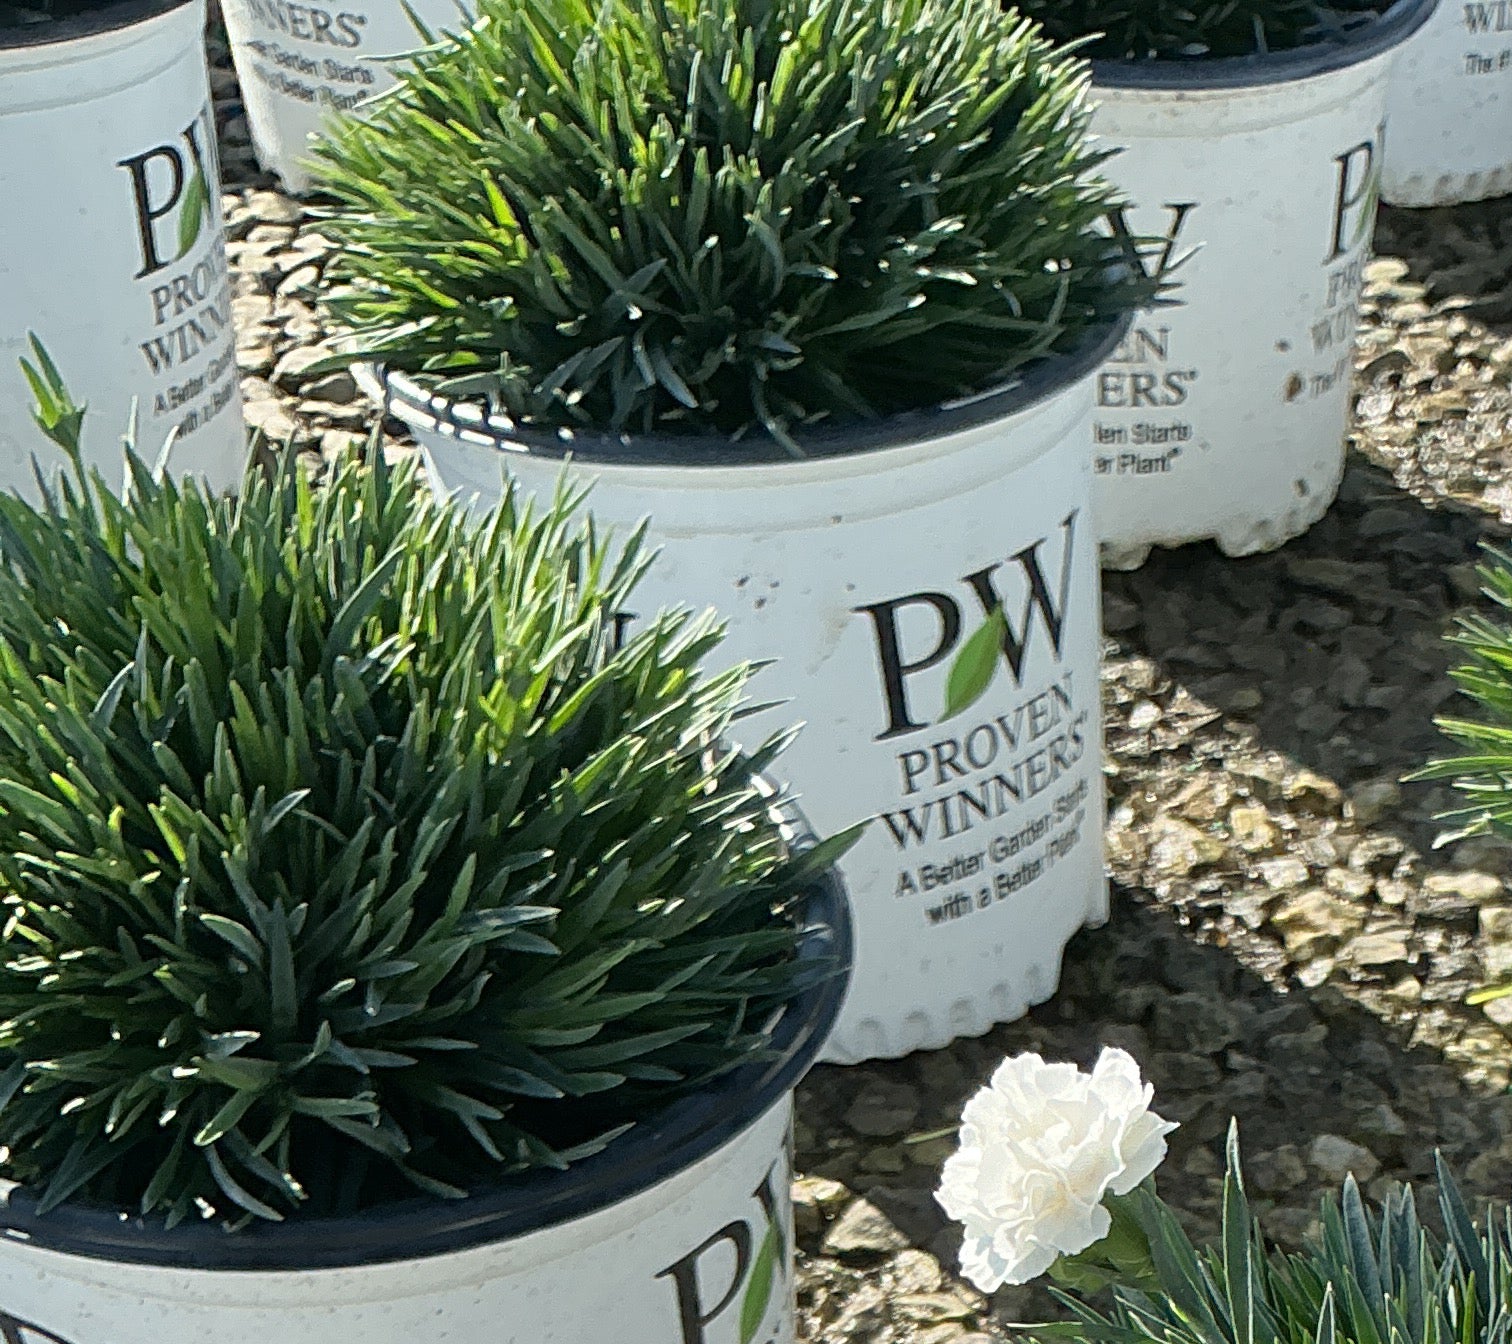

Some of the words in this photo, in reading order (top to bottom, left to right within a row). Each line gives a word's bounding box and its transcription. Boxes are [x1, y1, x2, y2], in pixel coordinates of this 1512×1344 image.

[852, 507, 1080, 743] PW
[896, 669, 1075, 796] PROVEN
[894, 870, 918, 899] A
[917, 849, 986, 892] Better
